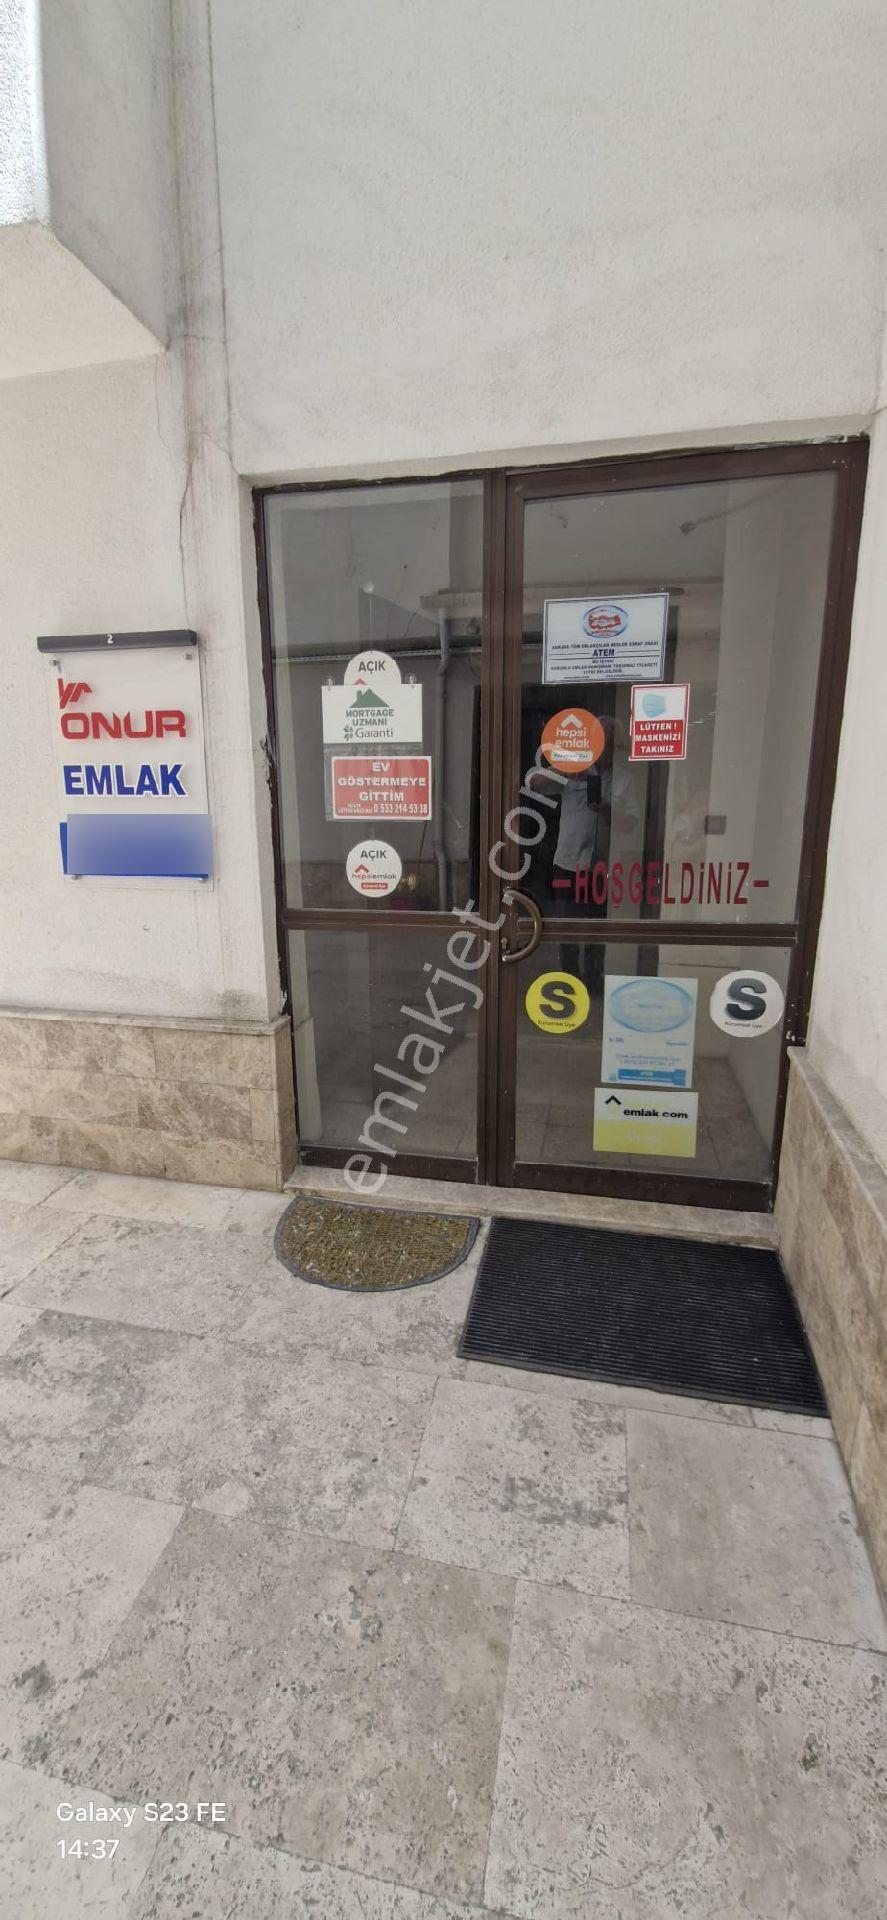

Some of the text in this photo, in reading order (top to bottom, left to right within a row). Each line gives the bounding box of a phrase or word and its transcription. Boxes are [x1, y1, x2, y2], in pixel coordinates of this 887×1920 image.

[107, 633, 114, 644] 2
[592, 648, 615, 657] ATEM
[358, 660, 386, 674] AÇIK
[346, 709, 395, 718] MORTGAGE
[60, 710, 187, 740] ONUR
[355, 728, 393, 738] Garanti
[556, 727, 587, 739] hepsi
[555, 738, 590, 749] emlak
[372, 762, 390, 772] EV
[63, 764, 187, 796] EMLAK
[337, 775, 427, 787] GÖSTERMEYE
[359, 789, 404, 802] GİTTİM
[360, 849, 389, 861] AÇIK
[539, 981, 576, 1019] S
[726, 978, 767, 1021] S
[623, 1108, 659, 1117] emlak
